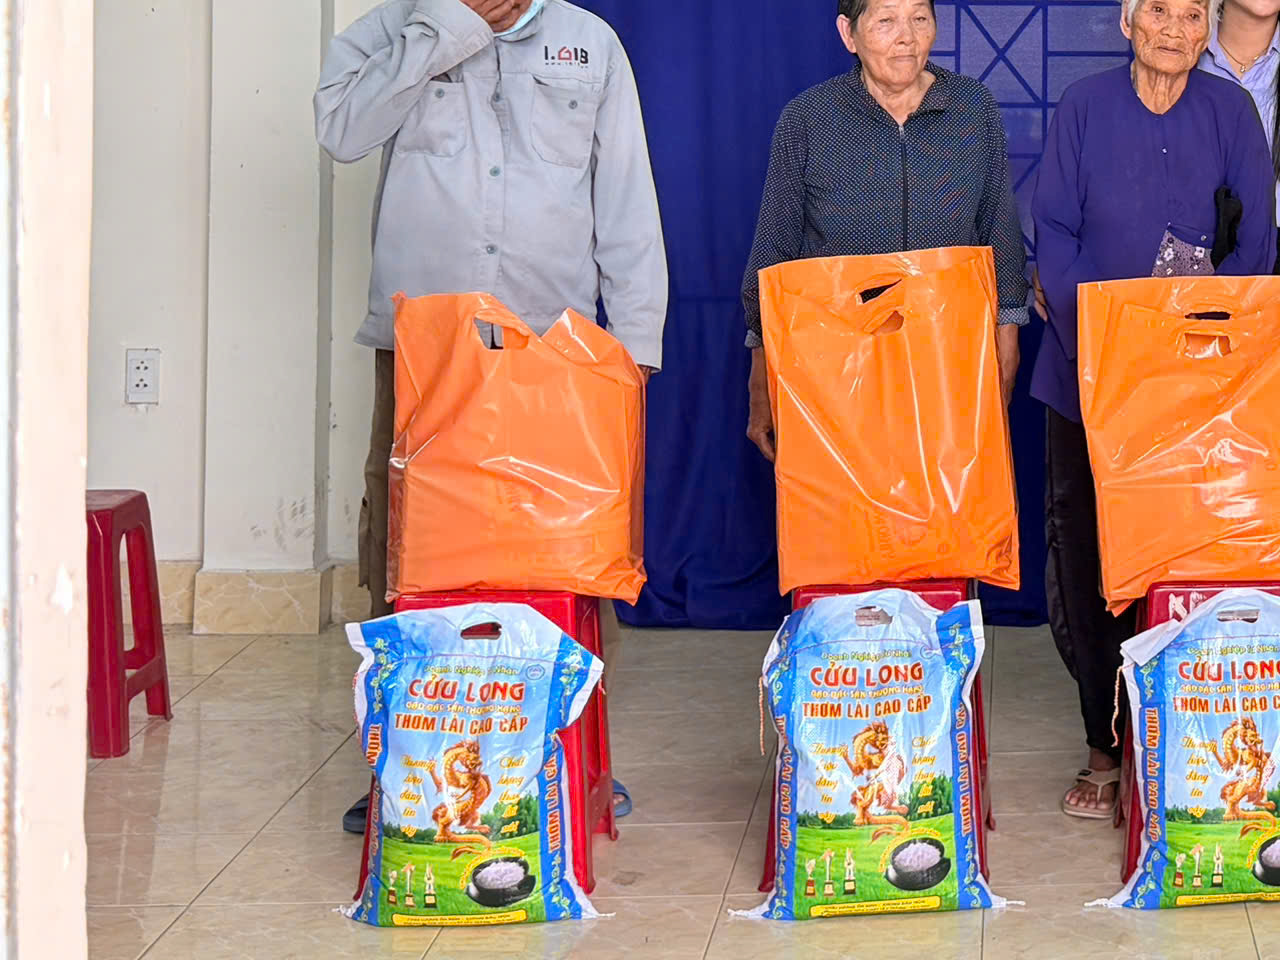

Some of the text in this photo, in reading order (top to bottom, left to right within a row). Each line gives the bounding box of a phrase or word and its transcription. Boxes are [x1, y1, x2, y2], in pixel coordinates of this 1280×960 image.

[810, 660, 924, 687] CỬU LONG
[1178, 655, 1223, 682] CỬU
[408, 673, 526, 702] CỬU LONG
[803, 693, 932, 719] THƠM LÀI CAO CẤP
[1173, 695, 1210, 713] THƠM
[1215, 695, 1237, 713] LÀI
[1242, 696, 1268, 712] CAO
[394, 712, 529, 736] THƠM LÀI CAO CẤP
